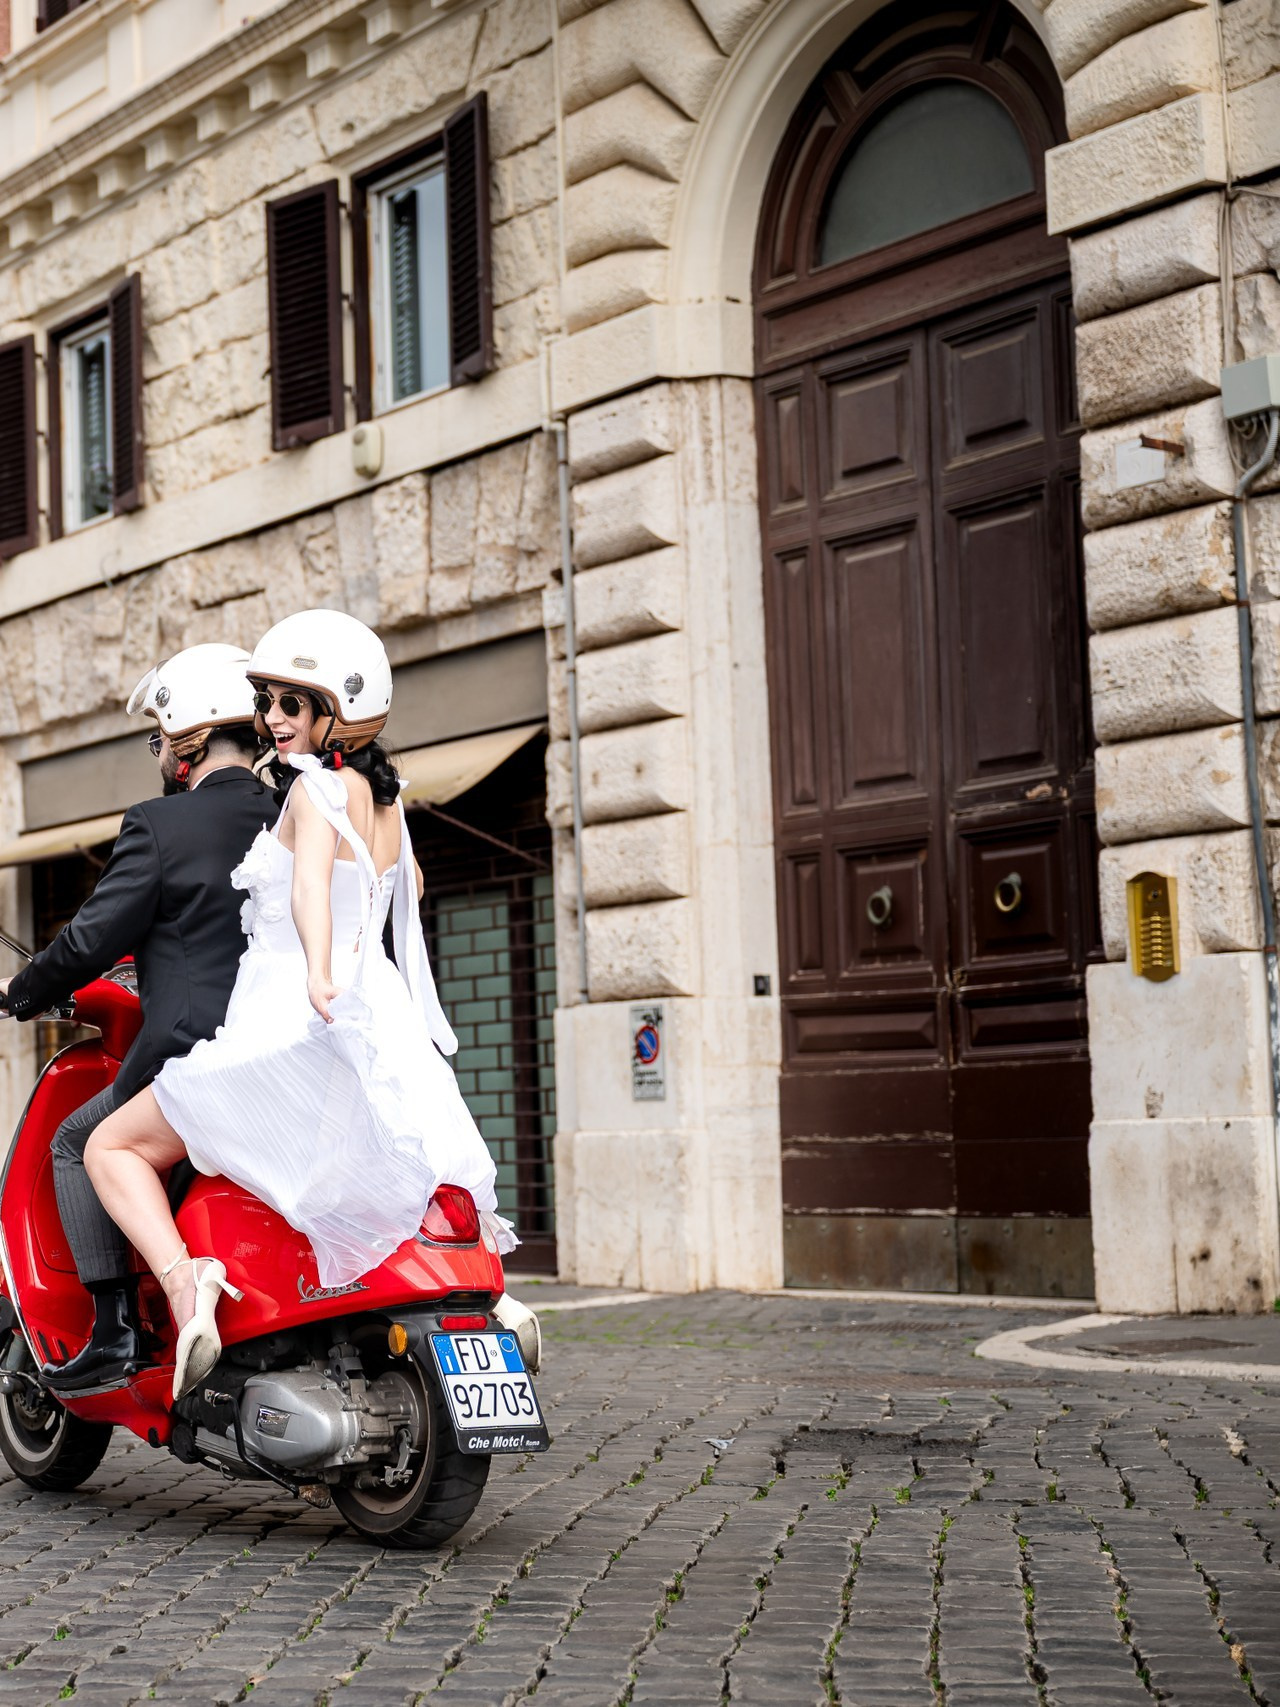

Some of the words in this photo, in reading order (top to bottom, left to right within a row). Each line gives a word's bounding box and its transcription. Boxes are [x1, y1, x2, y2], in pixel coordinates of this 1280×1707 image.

[297, 1273, 370, 1304] Vespa
[454, 1337, 491, 1371] FD
[453, 1382, 534, 1418] 92703
[468, 1436, 490, 1449] Che
